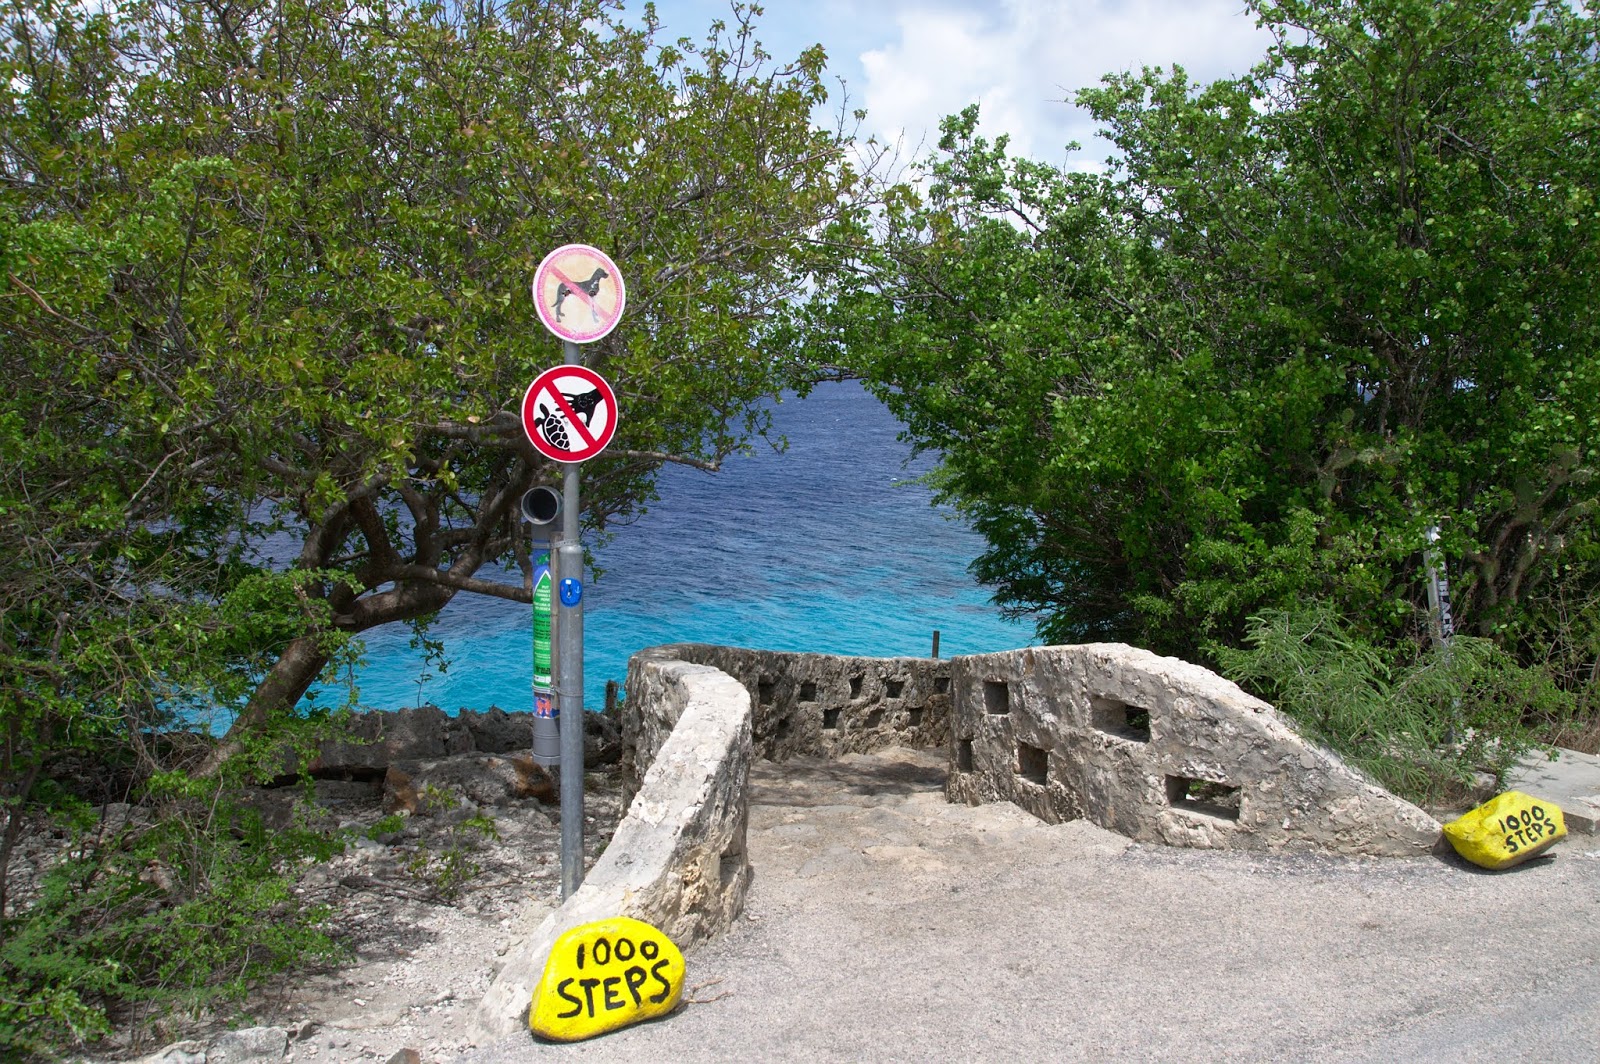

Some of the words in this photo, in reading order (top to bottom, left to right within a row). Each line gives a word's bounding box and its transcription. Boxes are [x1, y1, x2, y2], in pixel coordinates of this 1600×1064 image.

[1498, 805, 1544, 834] 1000
[1505, 818, 1556, 853] STEPS
[576, 937, 659, 969] 1000
[557, 959, 671, 1018] STEPS
